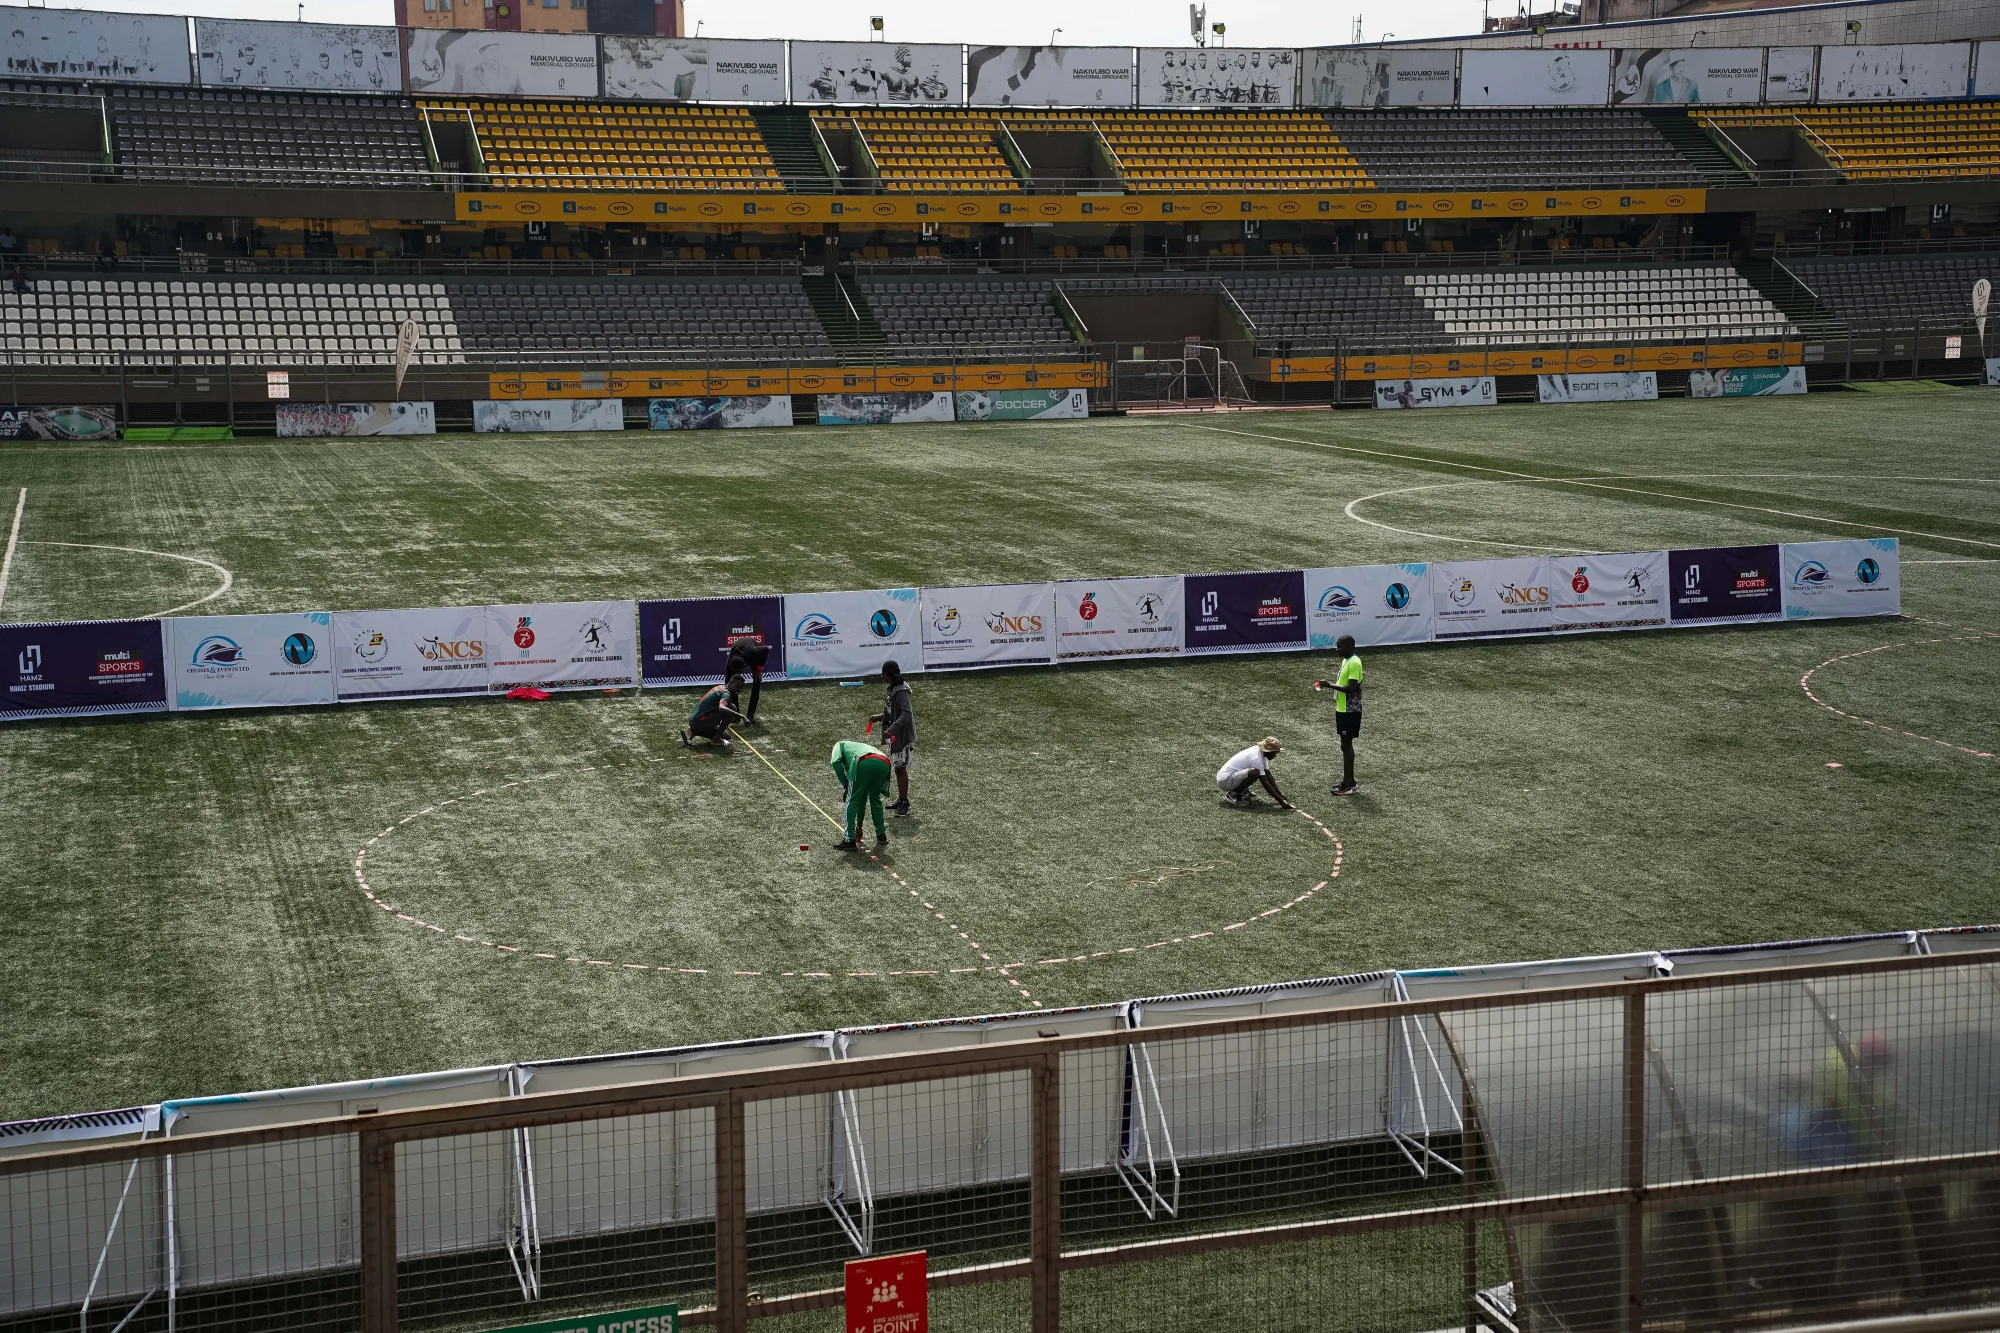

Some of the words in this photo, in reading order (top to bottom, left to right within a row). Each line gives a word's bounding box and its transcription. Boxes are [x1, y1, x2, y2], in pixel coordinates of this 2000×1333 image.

[1421, 387, 1454, 398] GYM
[996, 400, 1046, 409] SOCCER
[0, 411, 29, 420] AF
[1736, 580, 1764, 588] SPORTS
[1513, 587, 1548, 602] NCS
[1262, 597, 1281, 606] multi
[1258, 606, 1288, 615] SPORTS
[1003, 616, 1042, 632] NCS
[732, 625, 753, 633] multi
[727, 636, 761, 644] SPTS
[437, 640, 483, 659] NCS
[104, 651, 130, 660] multi
[99, 662, 140, 672] SPORTS
[887, 1312, 919, 1322] ASSEMBLY
[597, 1315, 673, 1333] ACCESS
[873, 1319, 919, 1333] POINT
